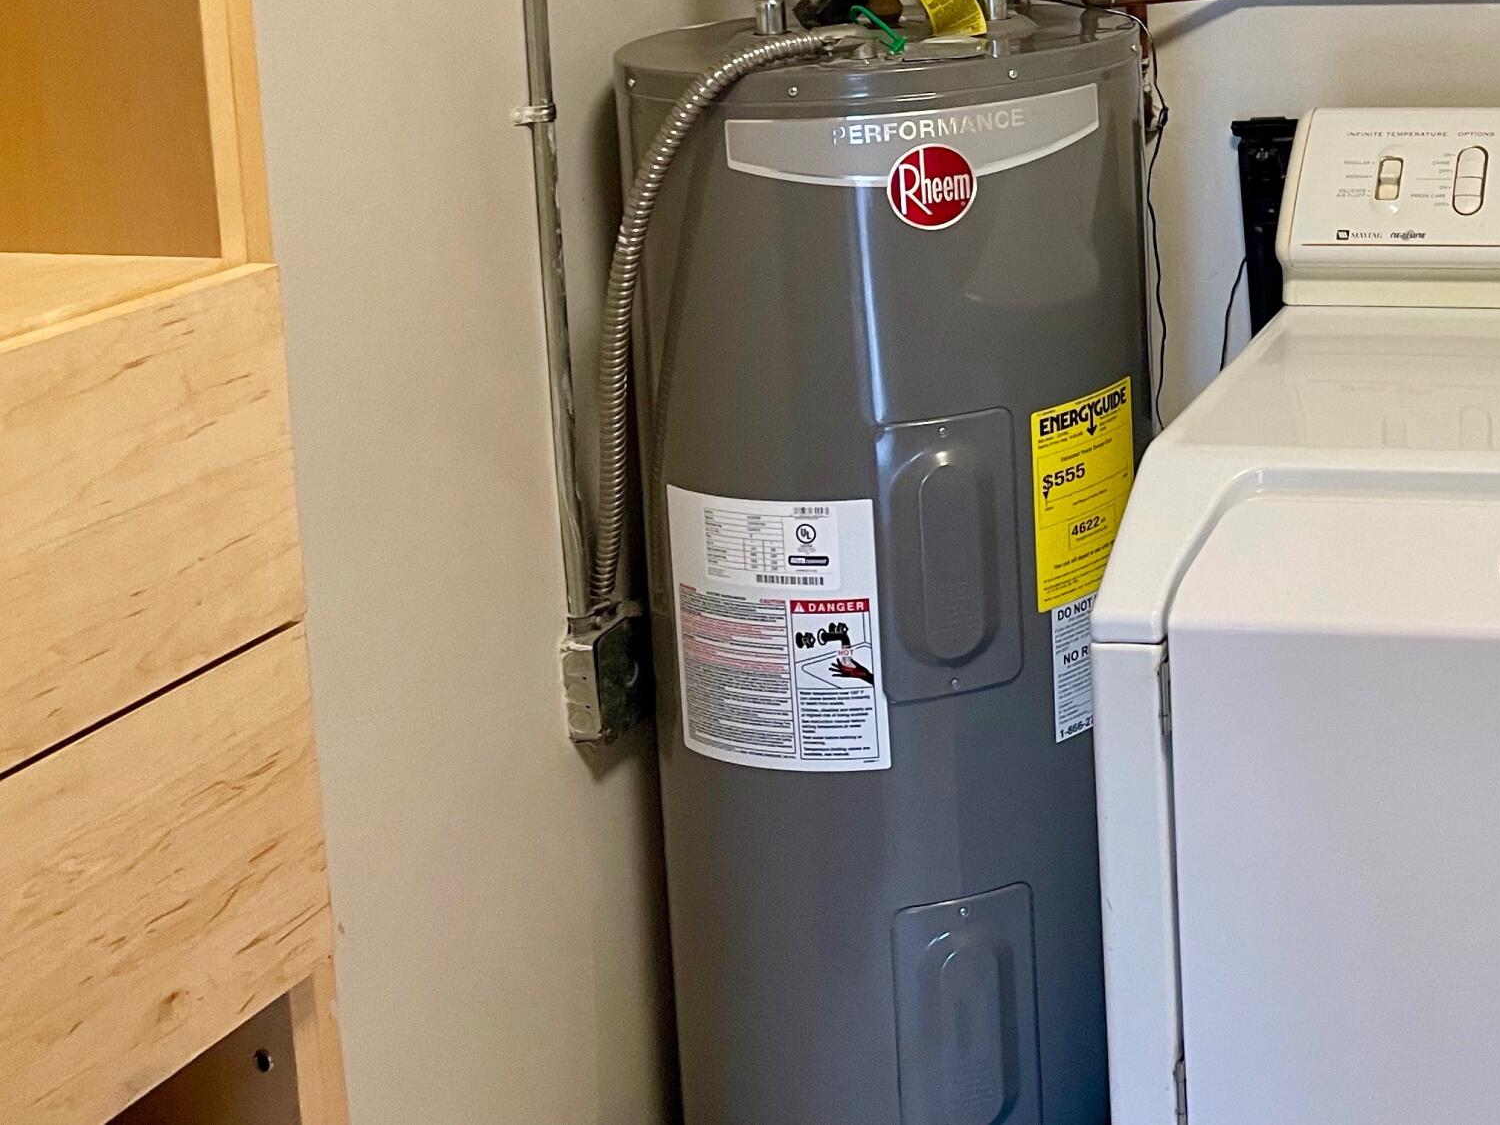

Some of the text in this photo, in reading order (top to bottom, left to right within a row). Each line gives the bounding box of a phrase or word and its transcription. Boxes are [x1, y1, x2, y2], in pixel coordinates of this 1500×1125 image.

[832, 108, 1025, 145] PERFORMANCE
[897, 147, 972, 215] Rheem
[1039, 386, 1127, 437] ENERGYGUIDE
[1041, 462, 1086, 491] $555
[1070, 515, 1101, 537] 4622
[808, 601, 865, 612] DANGER
[1057, 597, 1093, 622] DO NOT
[837, 648, 854, 657] HOT
[1063, 648, 1079, 665] NO
